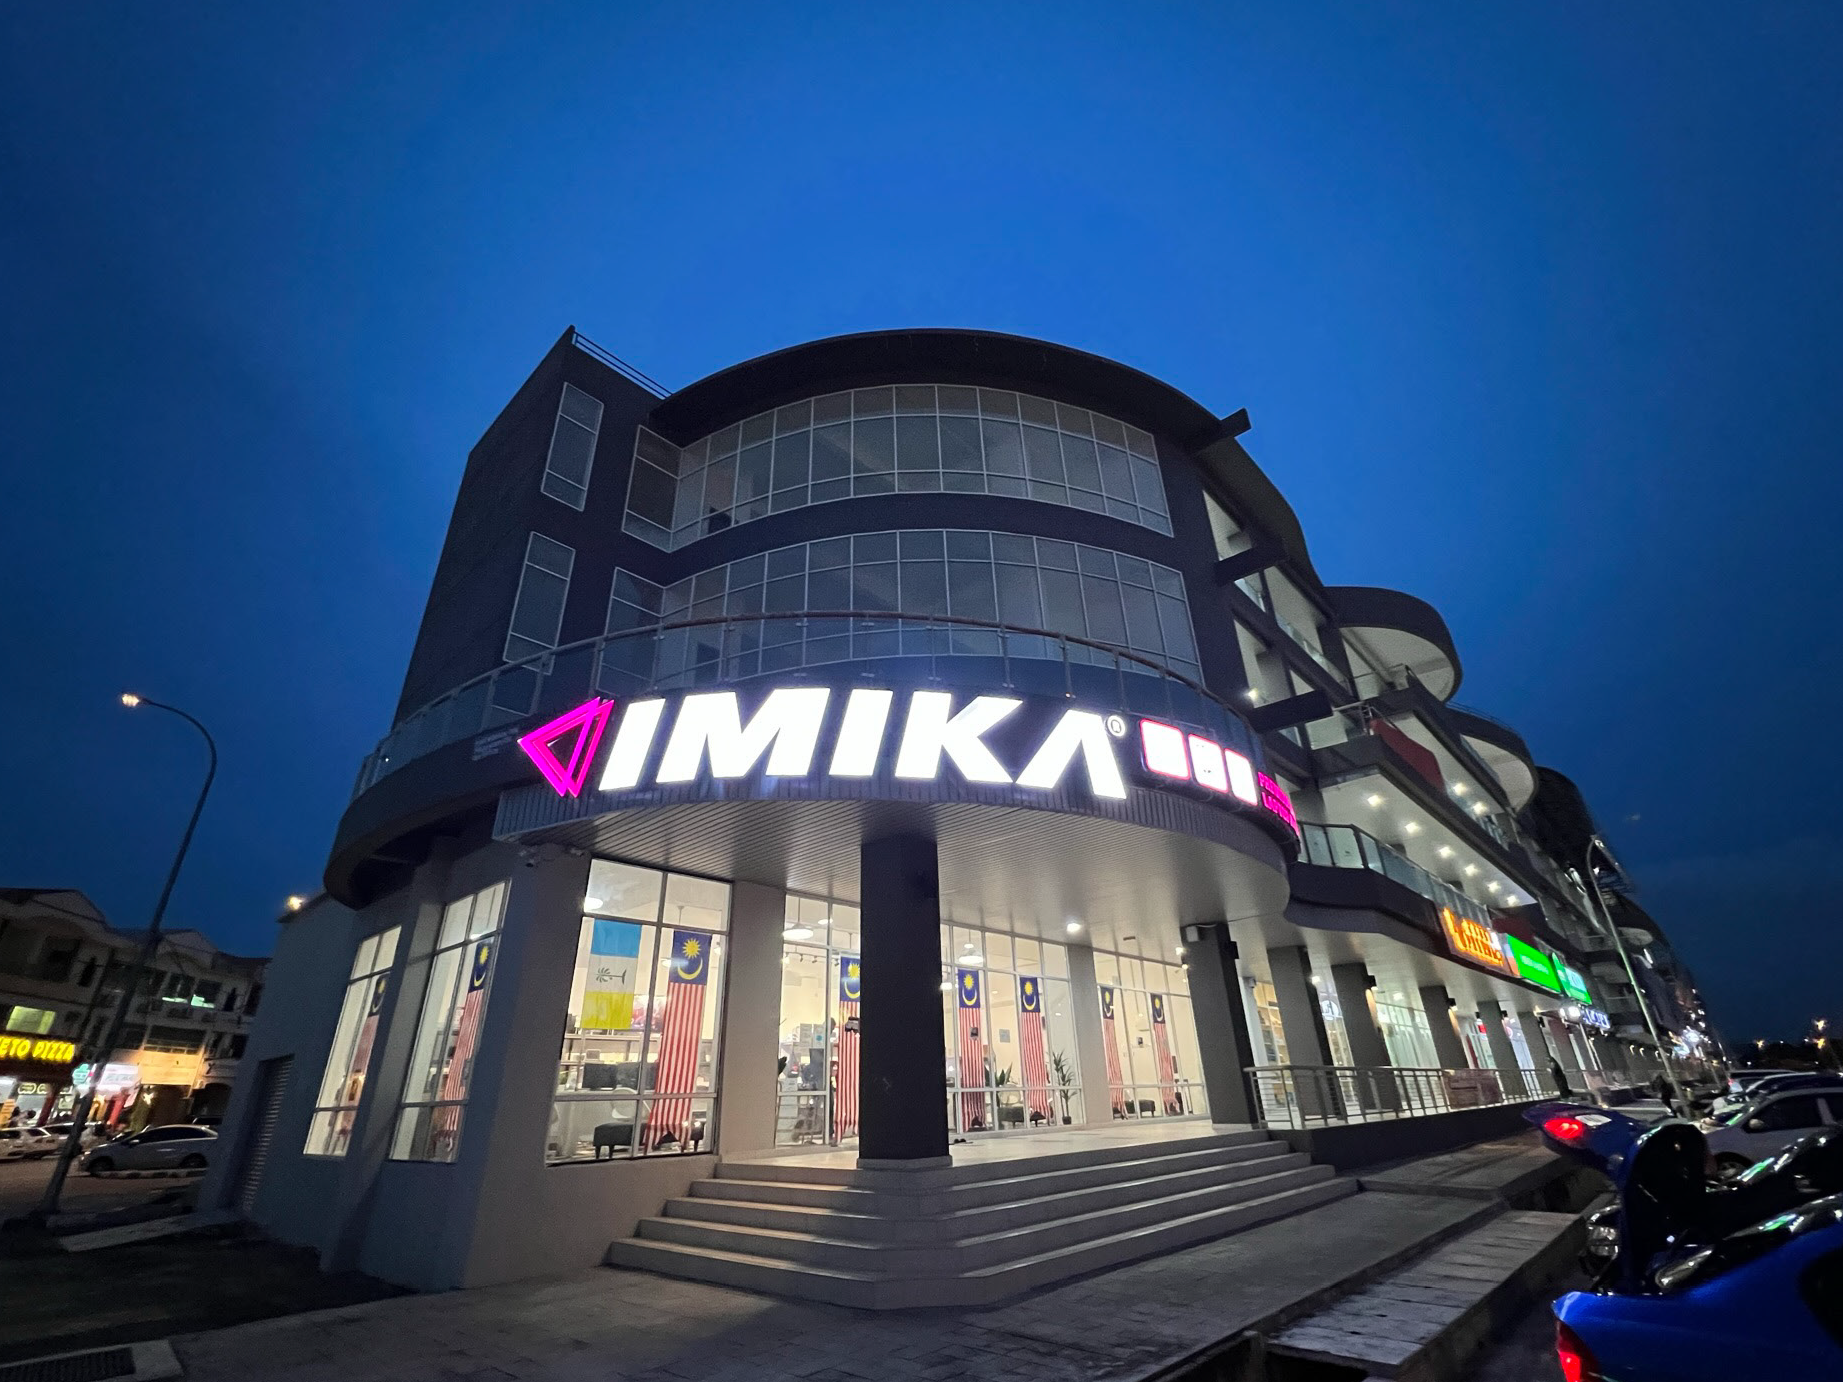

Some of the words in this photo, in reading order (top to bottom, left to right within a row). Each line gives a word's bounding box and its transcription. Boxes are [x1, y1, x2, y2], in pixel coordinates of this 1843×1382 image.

[598, 687, 1129, 801] IMIKA
[0, 1036, 31, 1059] ETO
[32, 1041, 75, 1063] PIZZA
